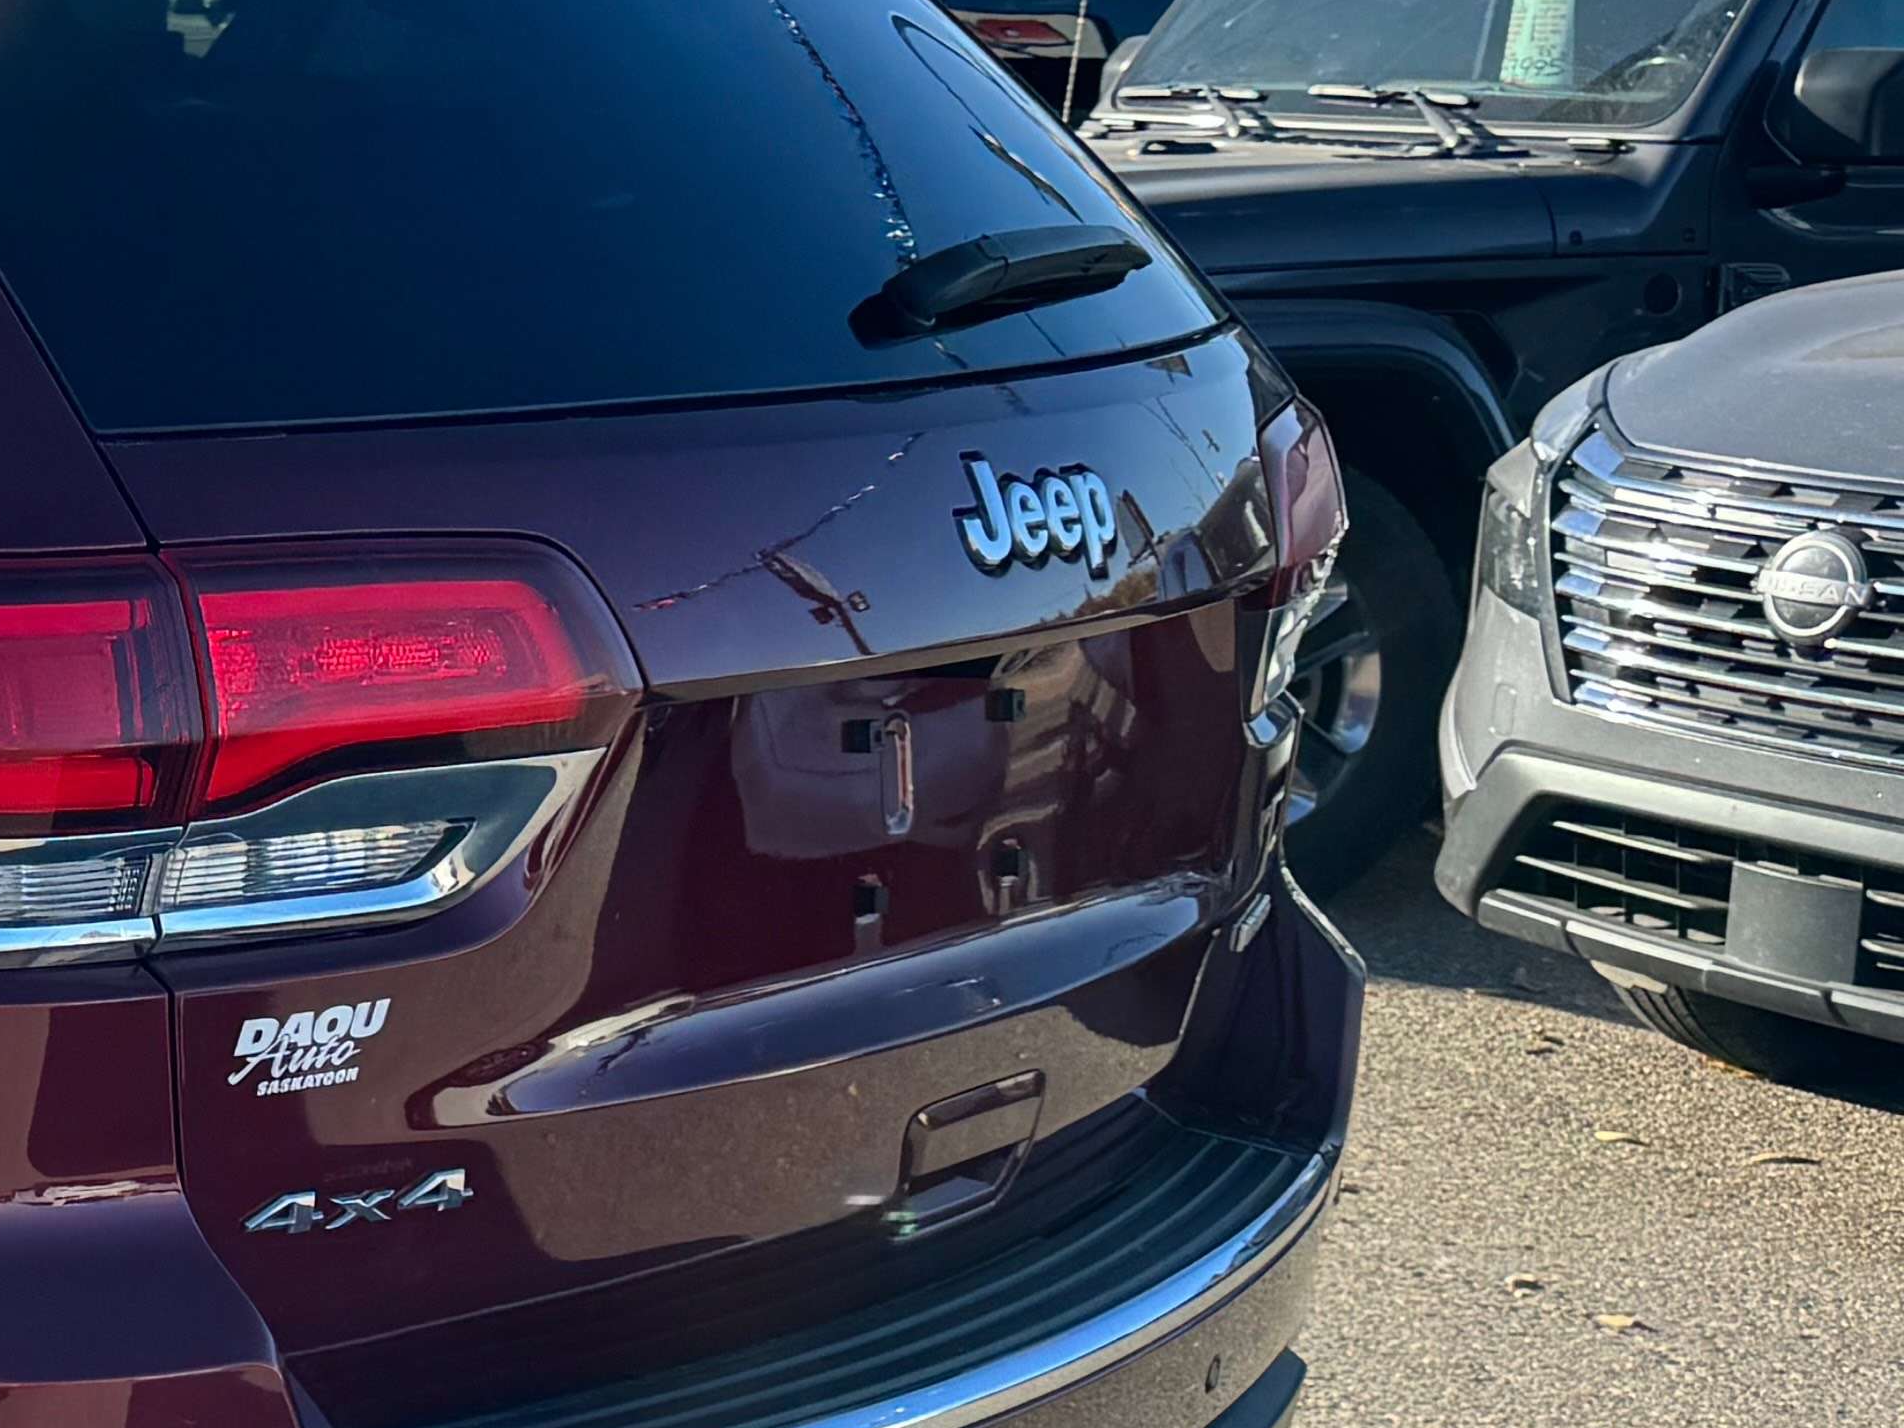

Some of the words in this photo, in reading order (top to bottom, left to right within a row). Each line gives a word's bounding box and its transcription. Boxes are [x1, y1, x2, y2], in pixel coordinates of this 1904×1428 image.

[955, 453, 1116, 576] Jeep
[234, 998, 391, 1056] DAOU
[228, 1034, 362, 1085] Auto
[256, 1067, 360, 1097] SASKATOON
